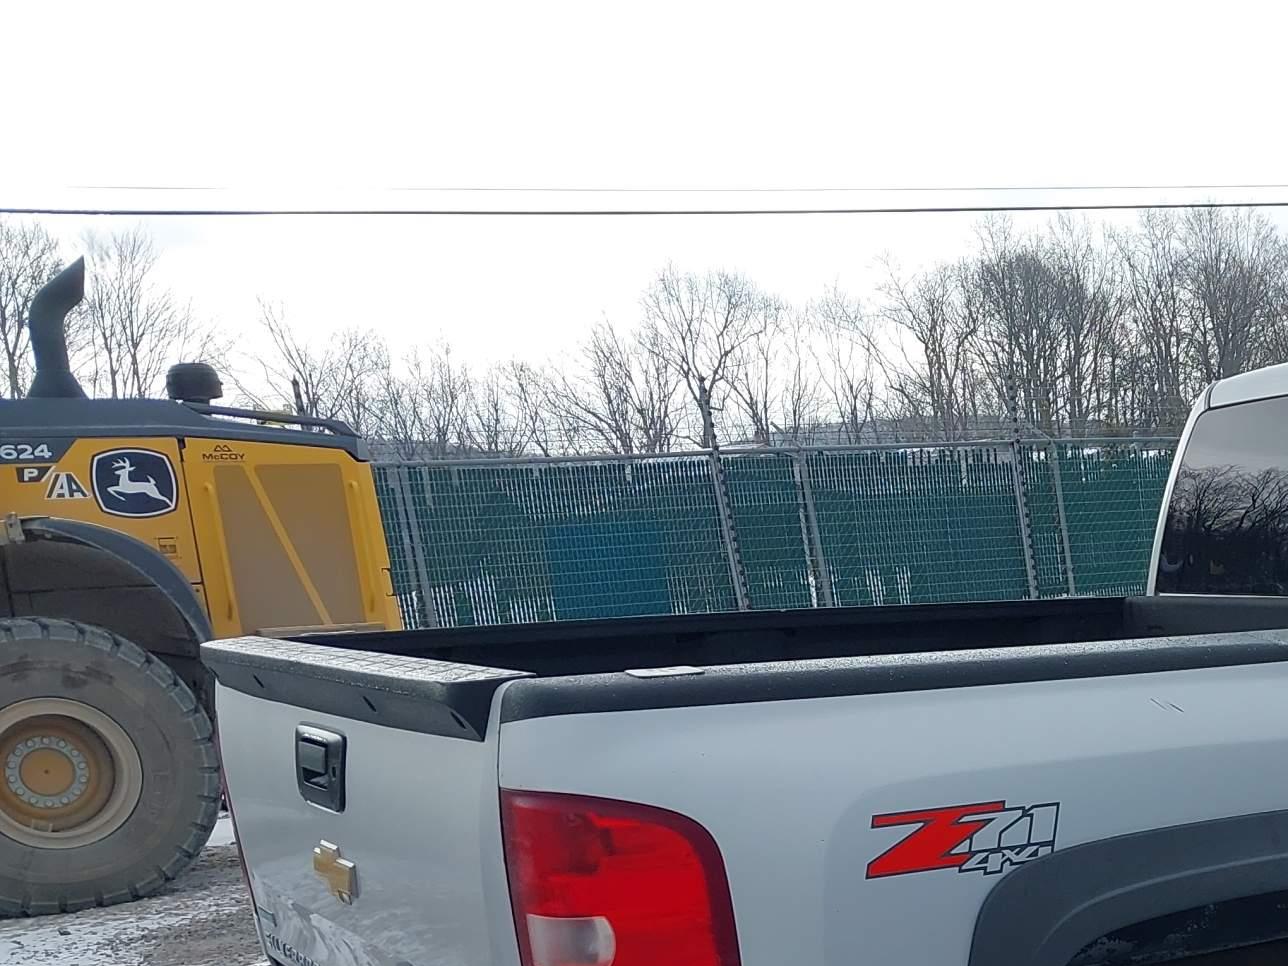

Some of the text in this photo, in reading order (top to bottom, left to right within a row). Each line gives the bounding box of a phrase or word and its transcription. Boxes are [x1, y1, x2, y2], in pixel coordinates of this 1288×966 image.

[0, 444, 53, 460] 624
[23, 468, 39, 482] P
[865, 800, 1061, 880] Z71
